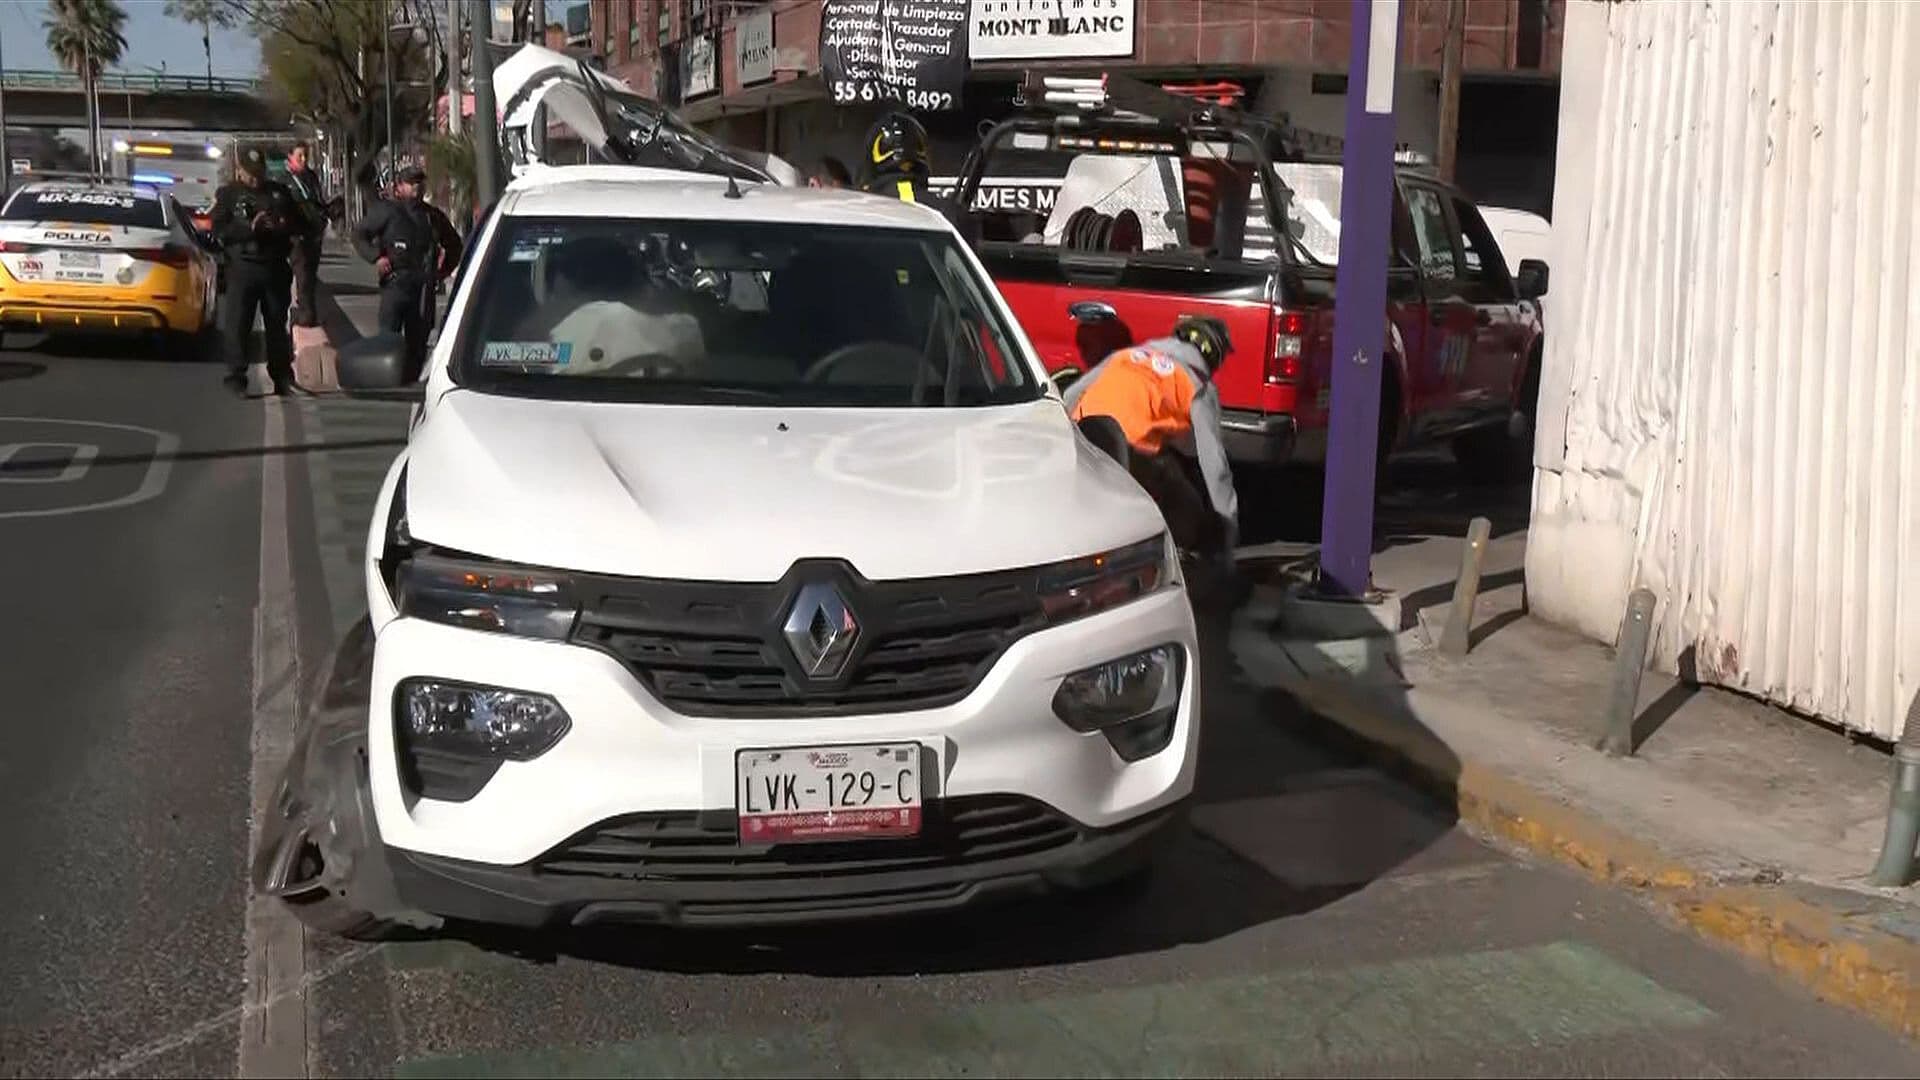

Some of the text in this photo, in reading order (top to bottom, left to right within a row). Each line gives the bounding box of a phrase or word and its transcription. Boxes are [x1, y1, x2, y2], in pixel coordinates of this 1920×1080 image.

[903, 6, 965, 21] Limpieza
[985, 0, 1118, 12] unifomes
[828, 17, 882, 31] Cortado
[978, 15, 1124, 36] MONT BLANC
[827, 33, 881, 49] Ayudan
[834, 81, 857, 101] 55
[906, 89, 953, 110] 8492
[745, 768, 914, 813] LVK-129-C
